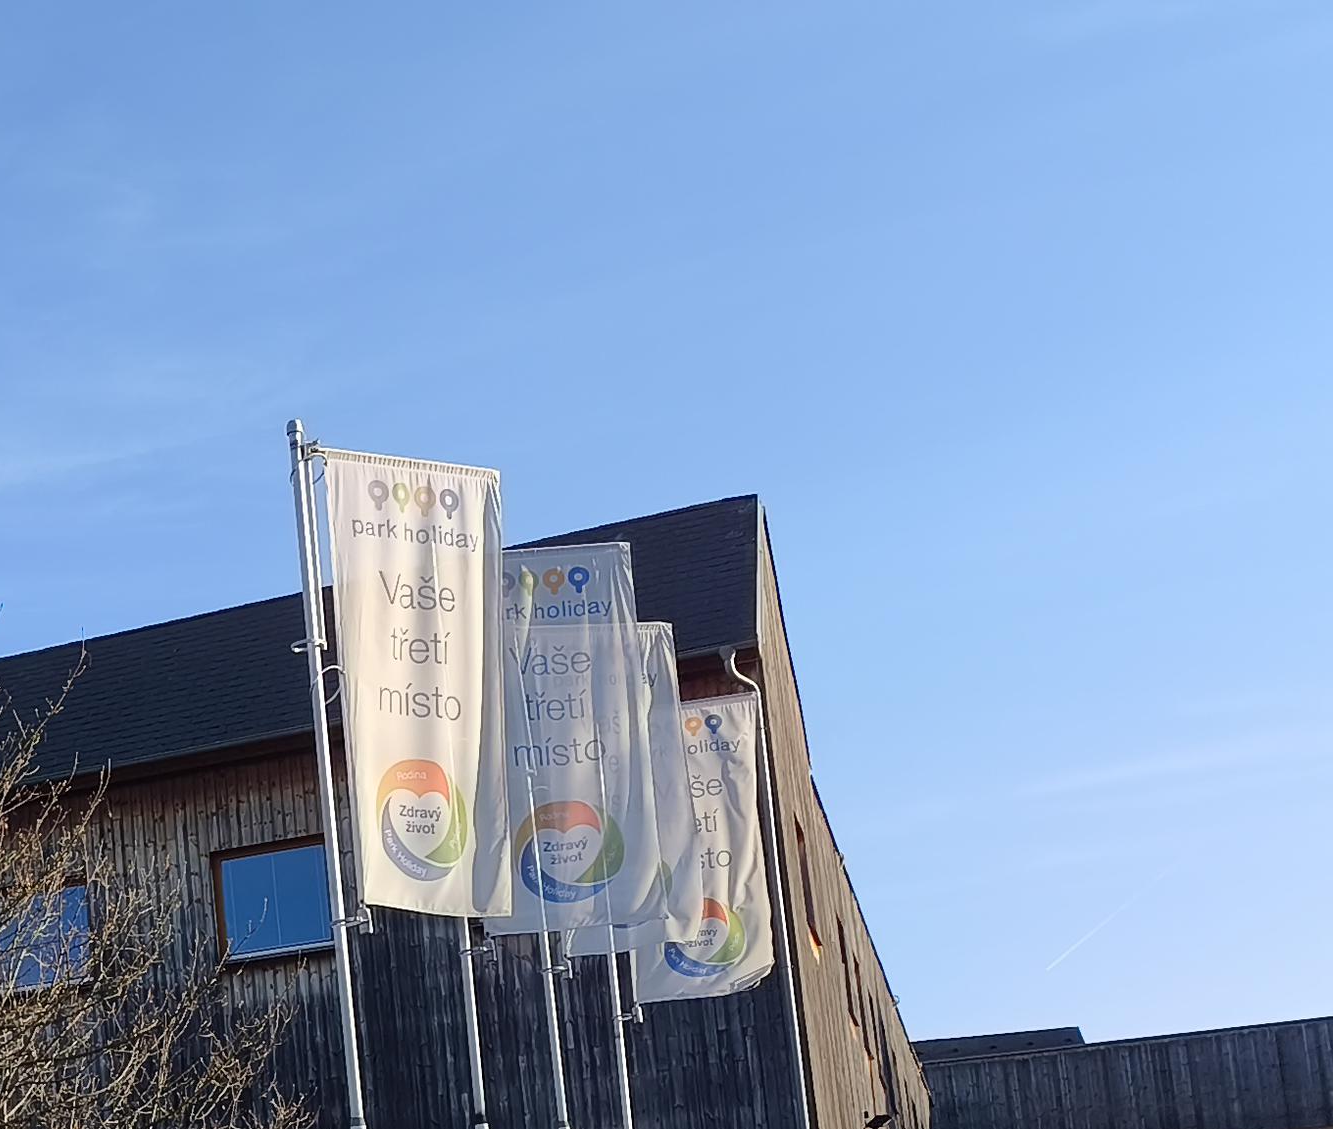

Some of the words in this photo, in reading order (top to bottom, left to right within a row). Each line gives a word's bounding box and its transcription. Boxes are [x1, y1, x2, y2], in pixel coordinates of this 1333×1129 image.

[352, 518, 397, 538] park
[404, 522, 479, 552] holiday
[378, 570, 456, 612] Vaše
[504, 603, 527, 621] rk
[534, 599, 613, 619] holiday
[390, 627, 451, 665] třetí
[508, 645, 592, 676] Vaše
[379, 682, 461, 721] místo
[525, 689, 587, 721] třetí
[514, 737, 607, 768] místo
[687, 739, 741, 756] oliday
[691, 774, 723, 798] še
[399, 804, 442, 822] Zdravý
[405, 820, 436, 835] život
[543, 836, 589, 853] Zdravý
[550, 851, 584, 865] život
